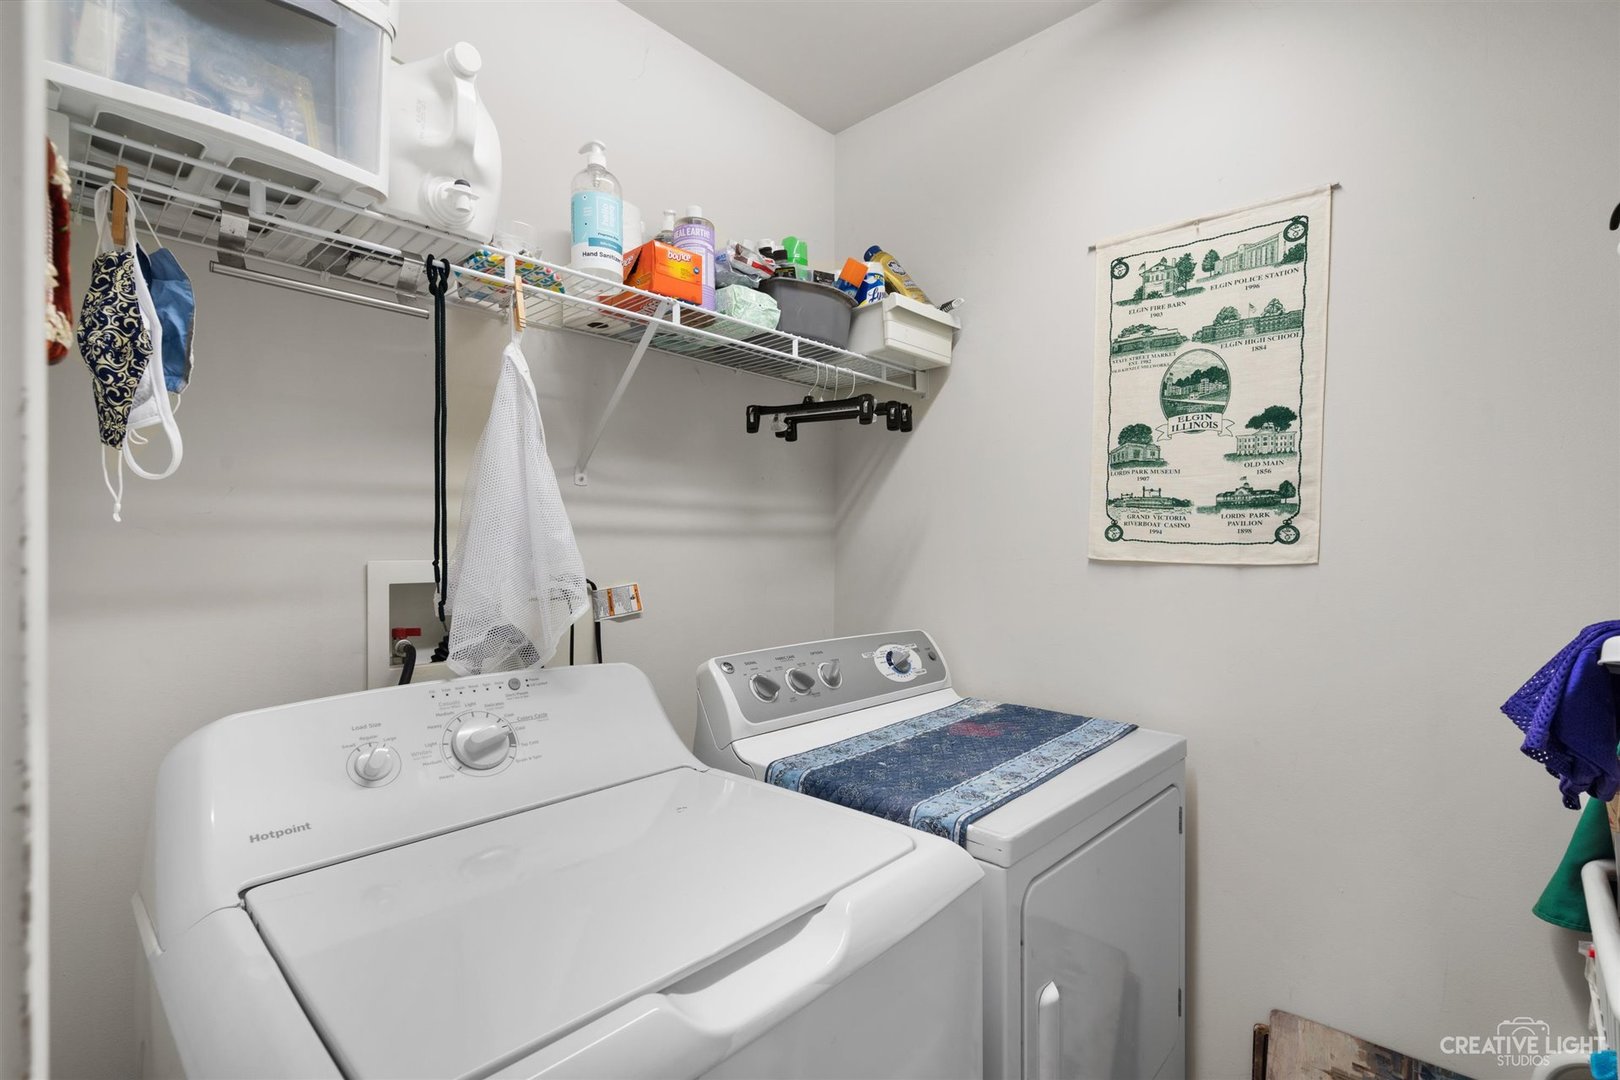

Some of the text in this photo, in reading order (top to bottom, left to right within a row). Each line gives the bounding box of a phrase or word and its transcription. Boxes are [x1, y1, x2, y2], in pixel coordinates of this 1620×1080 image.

[1210, 267, 1299, 290] ELGIN POLICE STATION
[1128, 306, 1149, 315] ELGIN
[1220, 332, 1301, 349] ELGIN HIGH SCHOOL
[1178, 414, 1212, 423] ELGIN
[1172, 421, 1218, 432] ILLINOIS
[249, 822, 312, 843] Hotpoint
